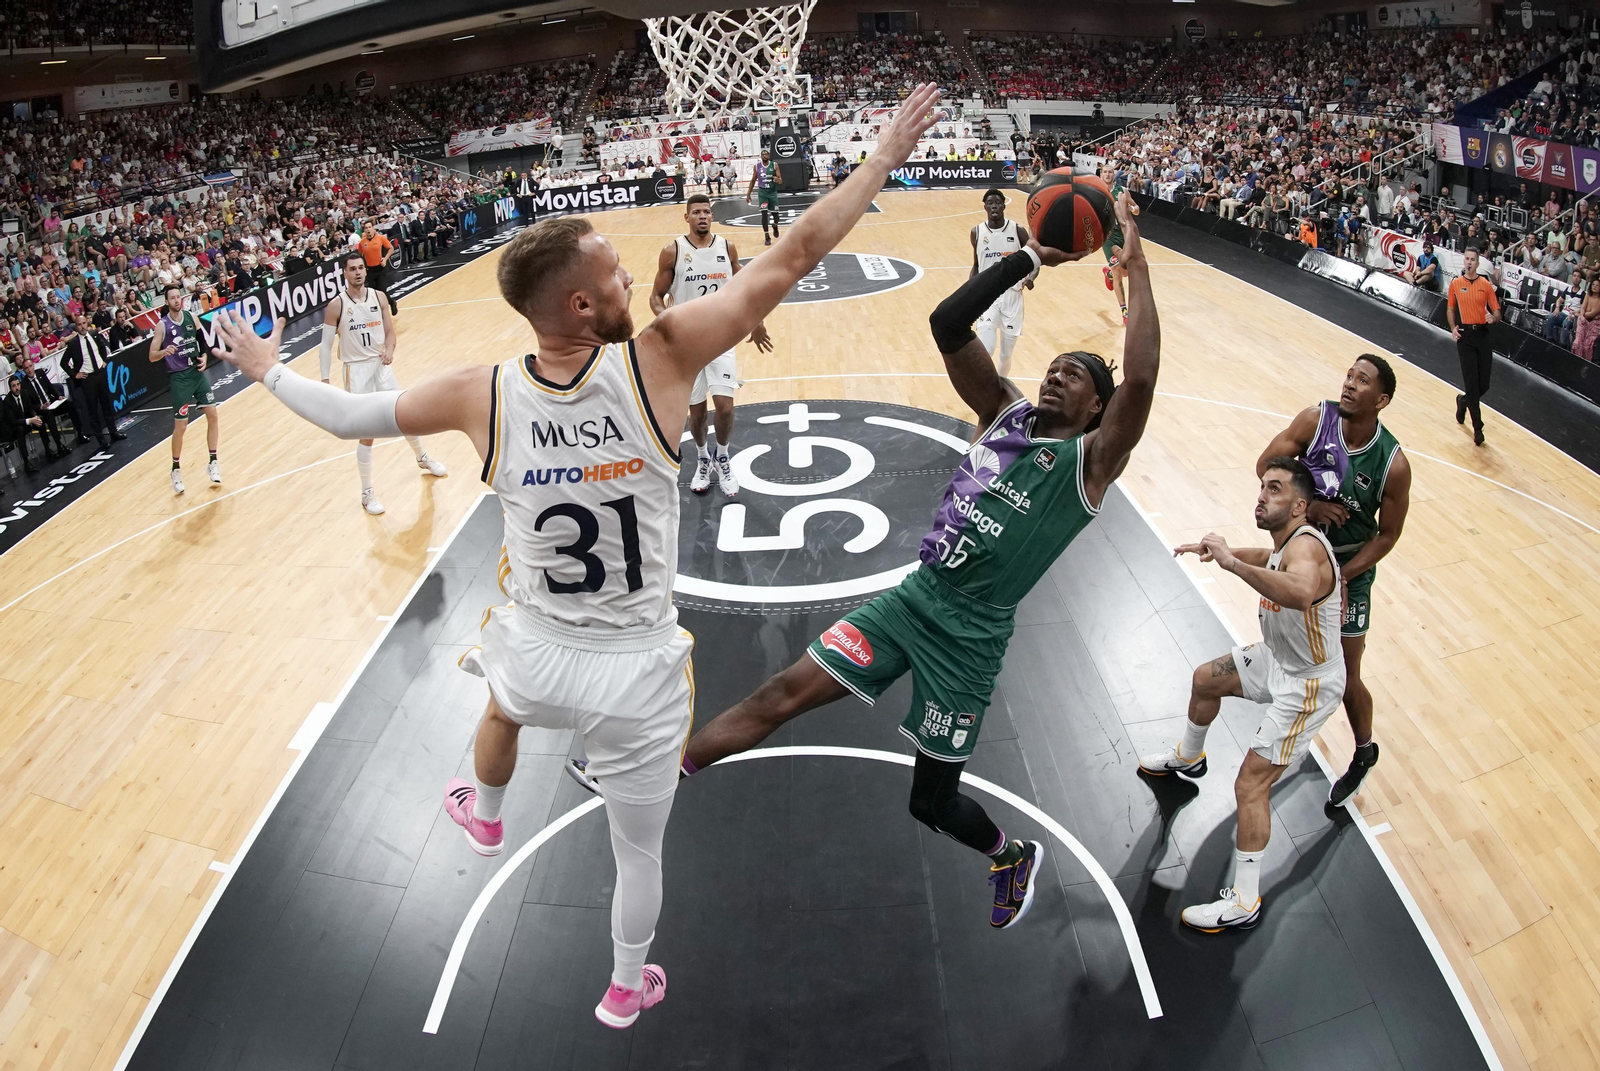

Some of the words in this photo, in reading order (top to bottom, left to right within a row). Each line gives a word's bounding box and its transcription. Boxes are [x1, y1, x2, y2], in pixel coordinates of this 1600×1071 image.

[891, 166, 925, 180] MVP
[929, 165, 992, 179] Movistar
[494, 198, 516, 224] MVP
[533, 185, 640, 212] Movistar
[685, 273, 728, 282] AUTOHERO
[1506, 270, 1520, 281] acb
[267, 261, 349, 326] Movist
[349, 320, 382, 332] AUTOHERO
[361, 332, 372, 347] 11
[530, 415, 625, 449] MUSA
[521, 457, 644, 487] AUTOHERO
[0, 450, 115, 534] vistar
[988, 475, 1031, 510] Unicaja
[534, 494, 644, 594] 31
[935, 523, 977, 569] 55
[958, 717, 971, 725] acb
